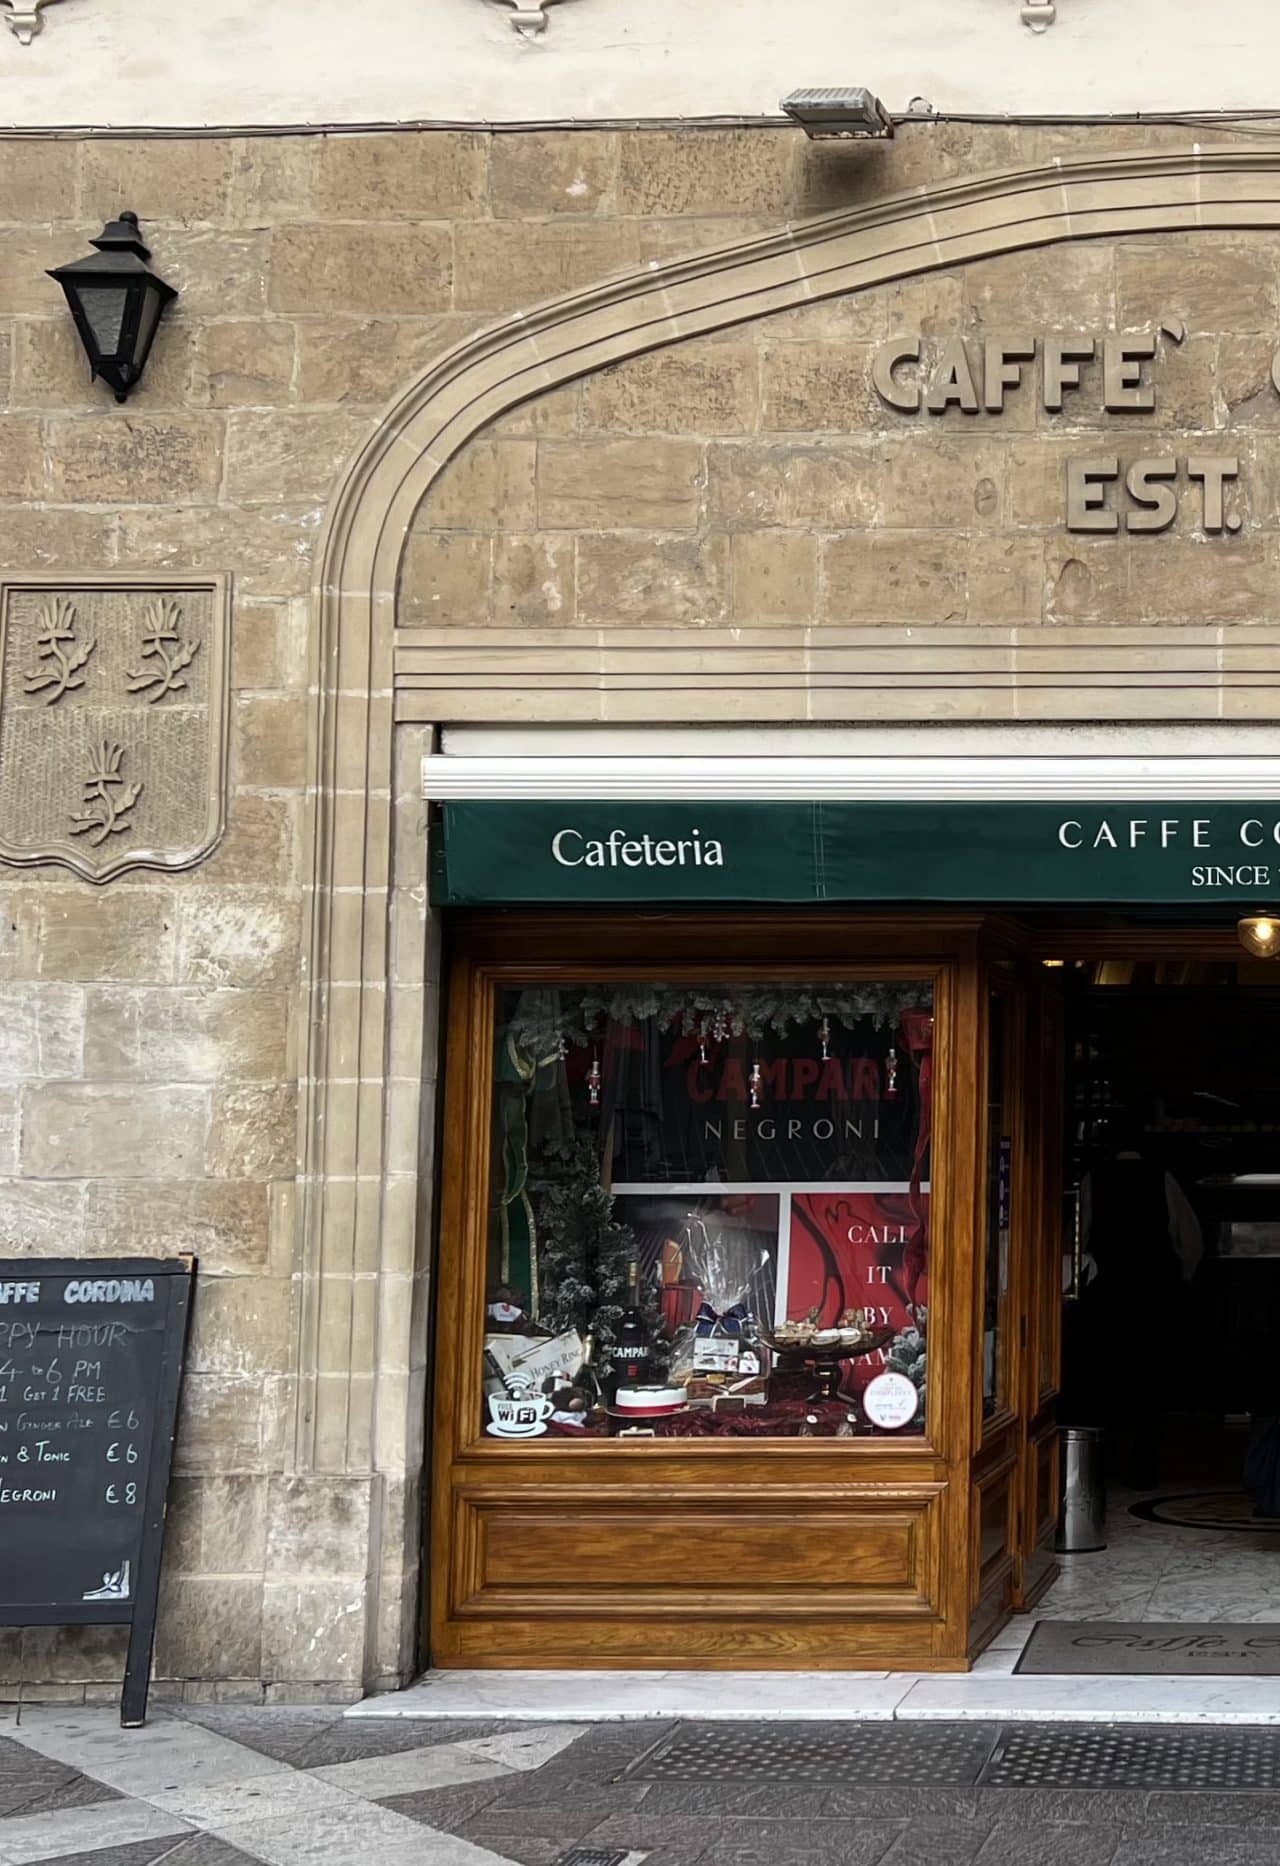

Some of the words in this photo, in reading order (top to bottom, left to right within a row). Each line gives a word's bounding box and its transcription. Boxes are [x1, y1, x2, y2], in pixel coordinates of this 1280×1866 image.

[1066, 456, 1242, 534] EST.
[1058, 819, 1211, 848] CAFFE
[552, 828, 724, 867] Cafeteria
[1191, 866, 1270, 887] SINCE
[704, 1118, 880, 1141] NEGRONI
[847, 1225, 910, 1244] CALL
[865, 1265, 892, 1284] IT
[64, 1279, 155, 1304] CORDINA
[863, 1306, 894, 1325] BY
[57, 1323, 129, 1349] HOUR
[0, 1359, 24, 1382] 4
[73, 1360, 102, 1380] PM
[67, 1384, 106, 1403] FREE
[17, 1446, 30, 1462] &
[0, 1481, 57, 1503] EGRONI
